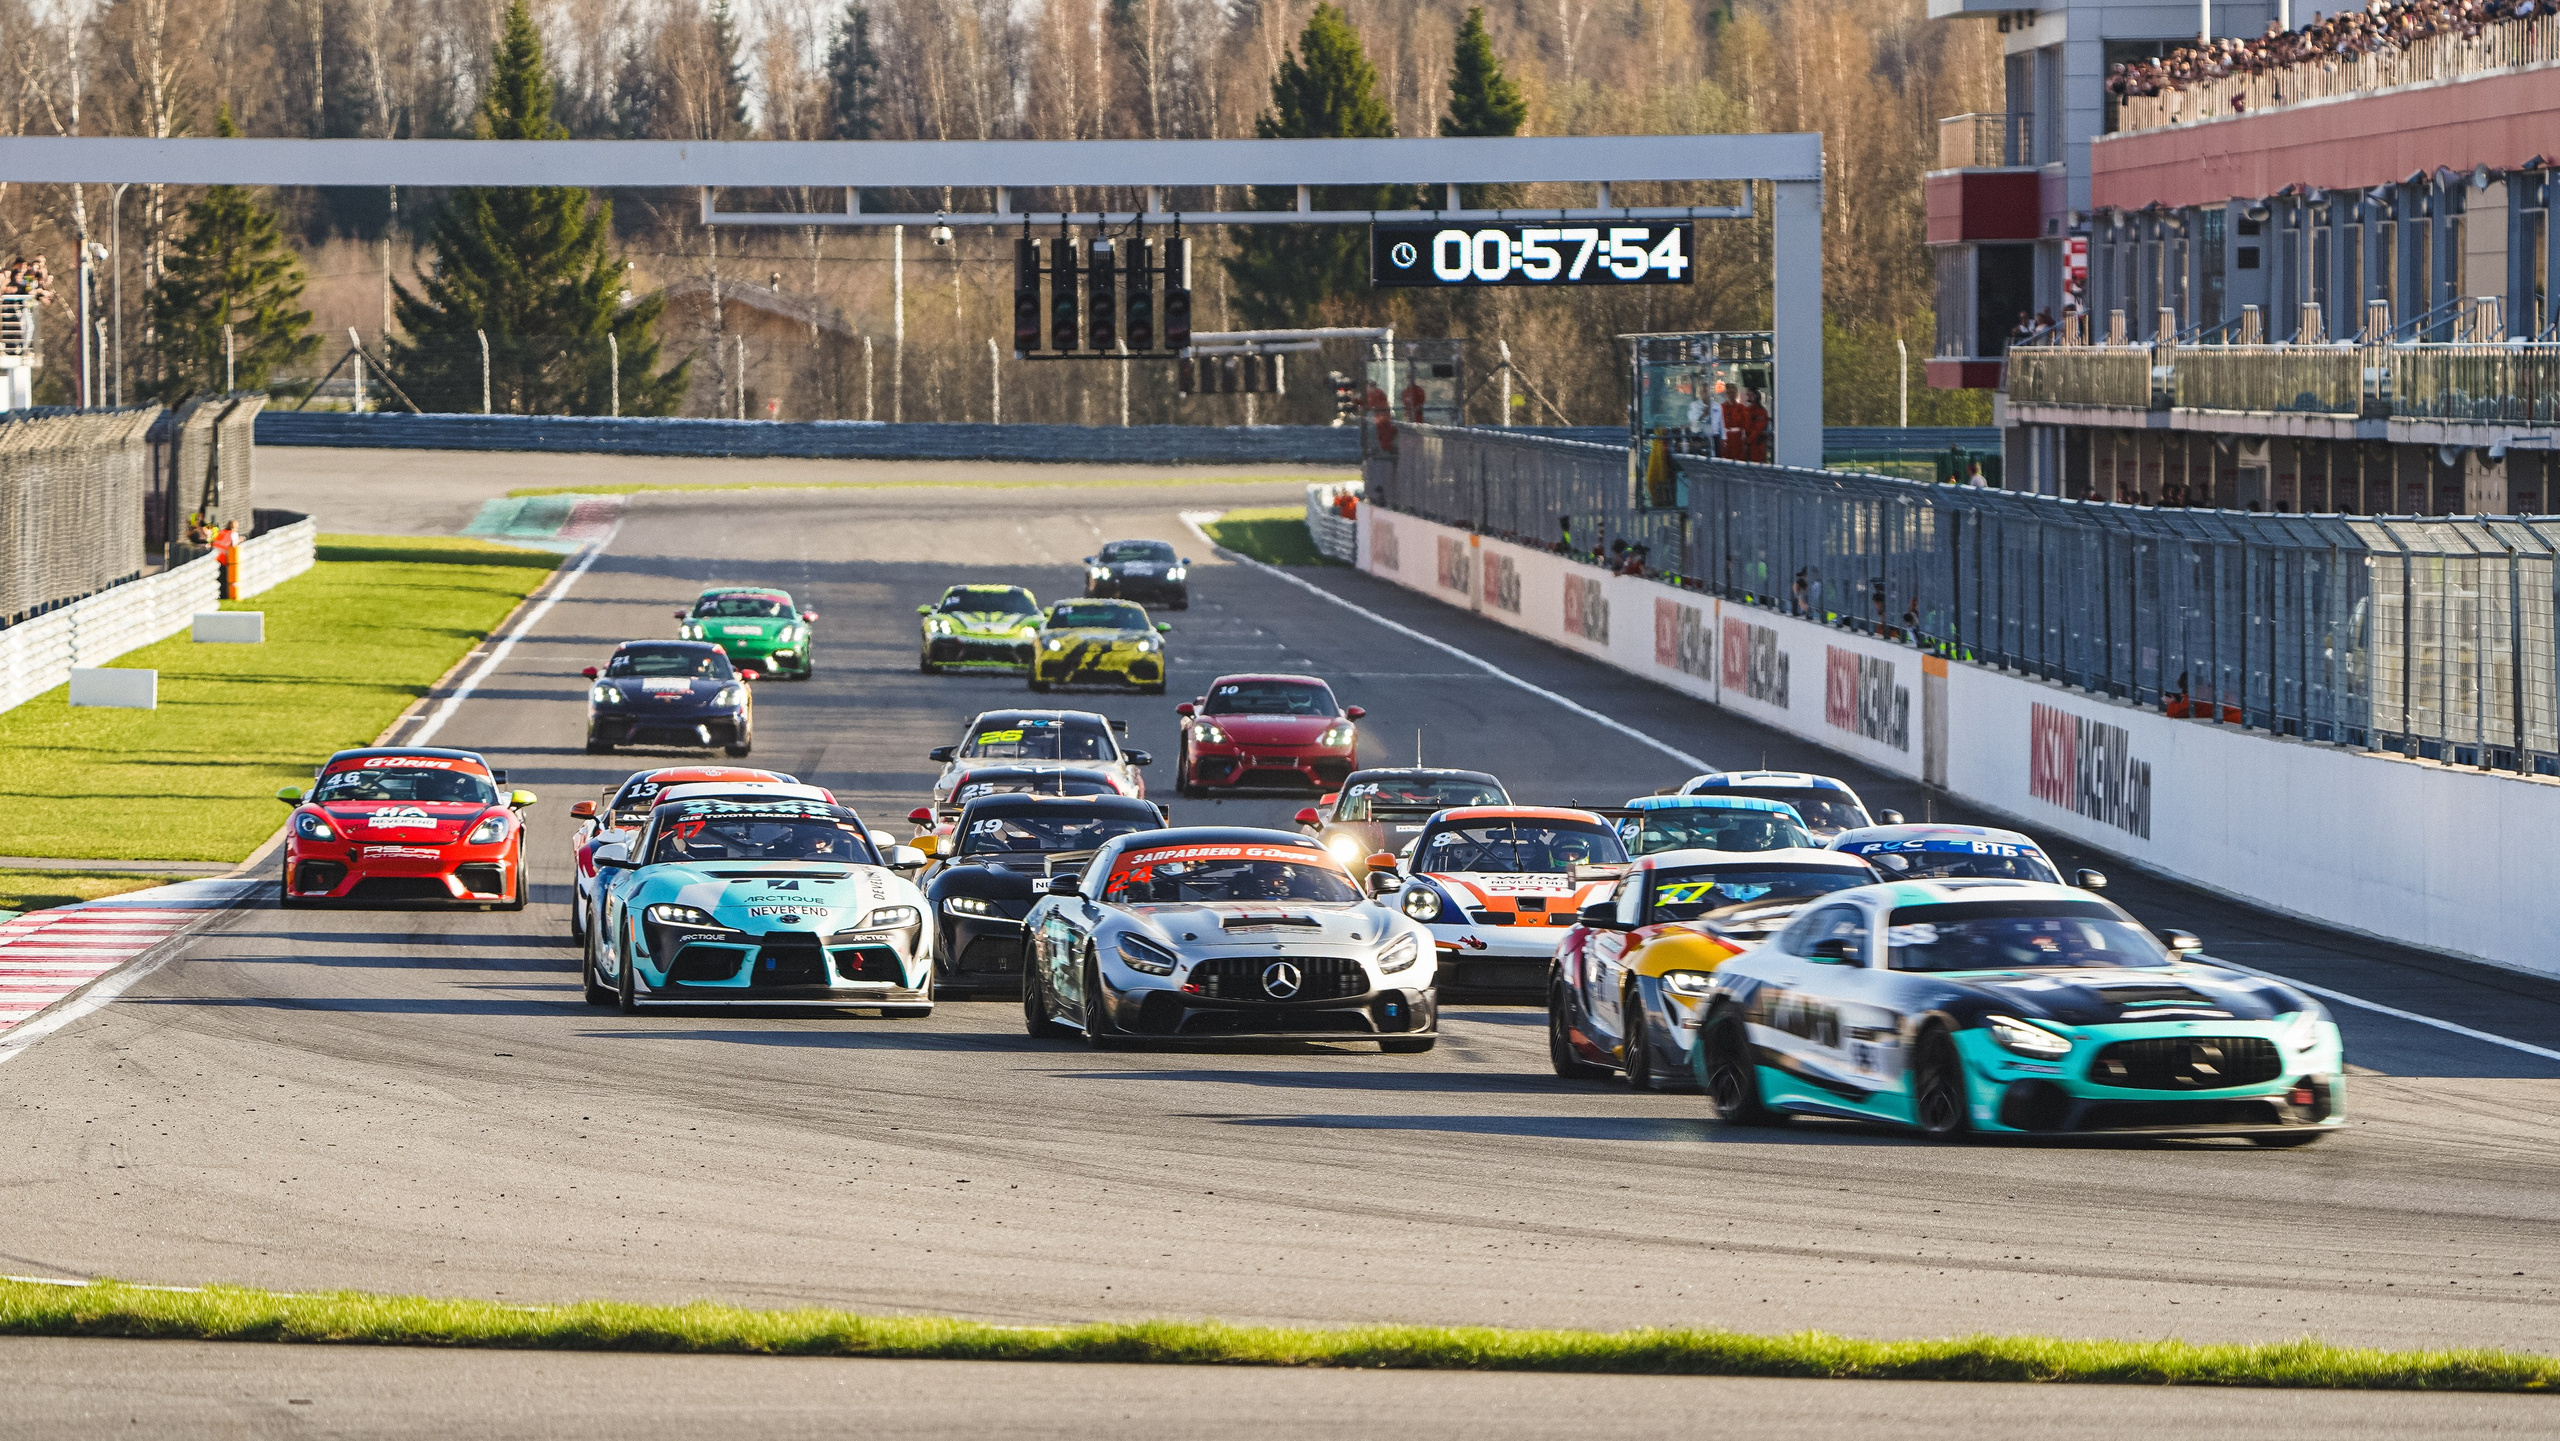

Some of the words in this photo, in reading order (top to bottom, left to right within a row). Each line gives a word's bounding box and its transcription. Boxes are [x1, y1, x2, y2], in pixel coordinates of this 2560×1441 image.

[1432, 227, 1688, 281] 00:57:54
[1219, 685, 1239, 695] 10
[978, 730, 1024, 745] 26
[327, 771, 361, 786] 46
[627, 782, 659, 798] 13
[961, 782, 994, 798] 25
[1349, 783, 1379, 797] 64
[671, 820, 706, 840] 17
[970, 818, 1003, 835] 19
[1432, 832, 1451, 847] 8
[1131, 847, 1242, 865] ЗАПРАВЛЕНО
[1971, 840, 2019, 858] ВТБ
[1107, 866, 1154, 894] 24
[743, 895, 825, 905] ARCTIQUE
[1654, 882, 1715, 907] 77
[750, 905, 797, 917] NEVER
[801, 906, 829, 917] END
[679, 932, 726, 942] ARCTIQUE
